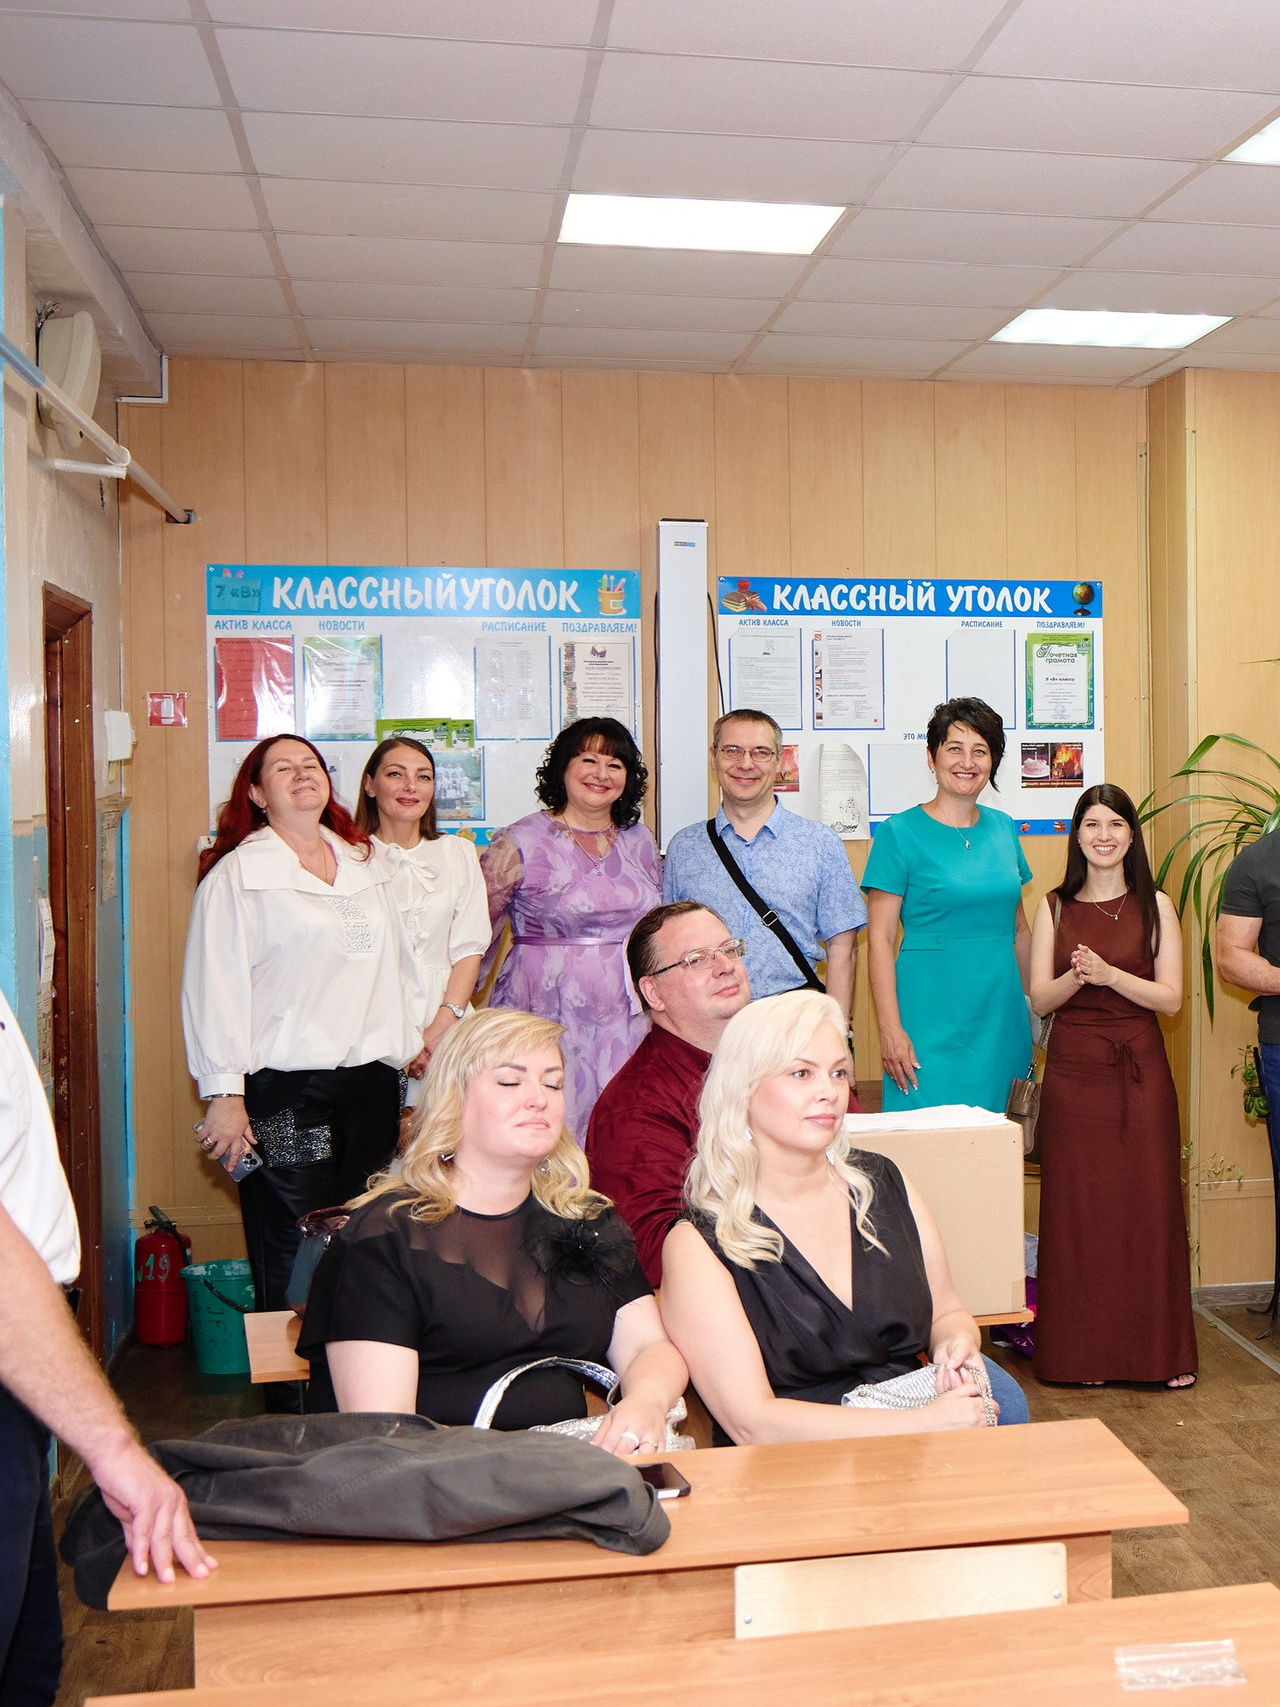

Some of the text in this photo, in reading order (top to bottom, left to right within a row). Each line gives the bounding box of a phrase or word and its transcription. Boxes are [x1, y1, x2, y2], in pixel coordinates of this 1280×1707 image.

[215, 585, 226, 598] 7
[272, 573, 582, 613] КЛАССНЫЙ УГОЛОК
[772, 580, 1053, 614] КЛАССНЫЙ УГОЛОК
[214, 619, 292, 631] АКТИВ КЛАССА
[318, 620, 365, 632] НОВОСТИ
[481, 621, 547, 633] РАСПИСАНИЕ
[561, 622, 637, 634] ПОЗДРАВЛЯЕМ!
[738, 619, 789, 627] АКТИВ КЛАССА
[831, 619, 862, 627] НОВОСТИ
[961, 620, 1003, 629] РАСПИСАНИЕ
[1036, 621, 1085, 629] ПОЗДРАВЛЯЕМ!
